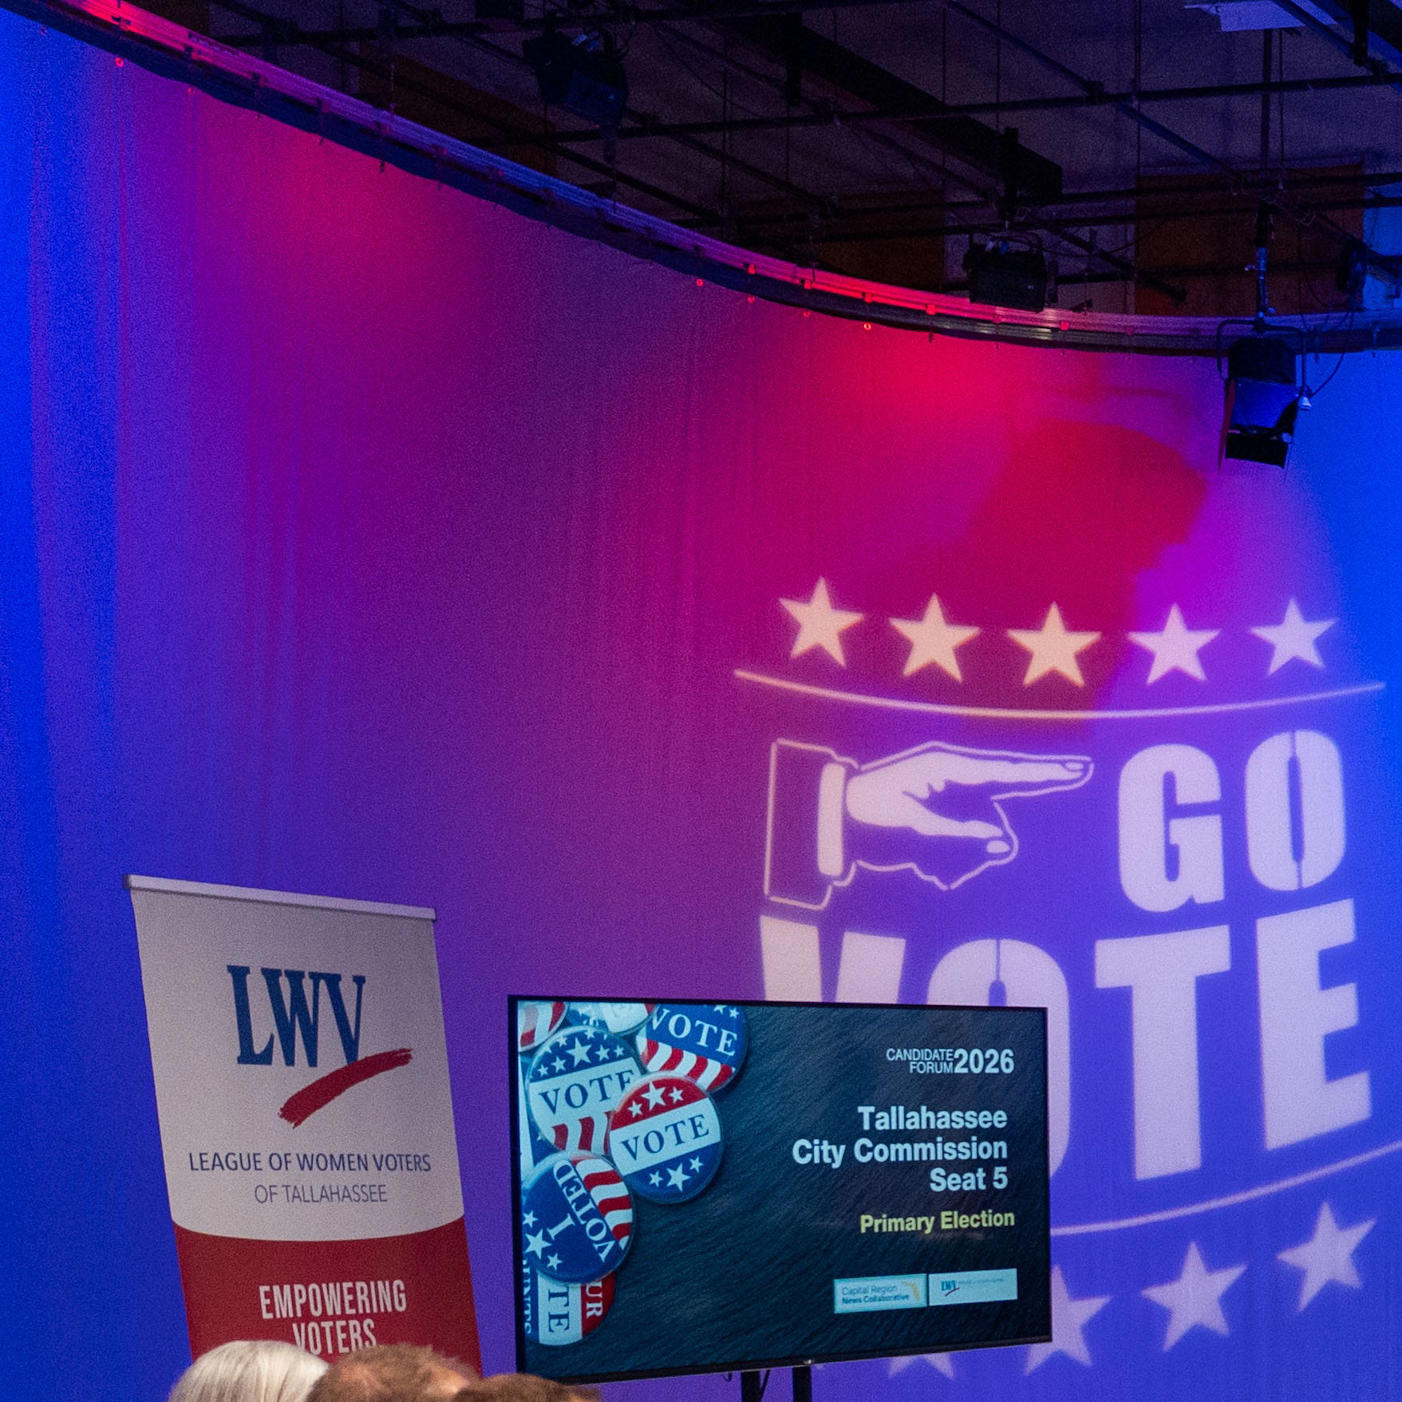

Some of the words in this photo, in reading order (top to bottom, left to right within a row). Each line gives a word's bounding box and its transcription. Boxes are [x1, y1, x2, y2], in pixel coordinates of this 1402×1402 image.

[1118, 730, 1346, 912] GO
[226, 964, 366, 1068] LWV
[651, 1007, 738, 1057] VOTE
[759, 898, 1371, 1181] TE
[886, 1048, 954, 1061] CANDIDATE
[909, 1061, 954, 1074] FORUM
[953, 1048, 1015, 1074] 2026
[857, 1105, 1008, 1130] Tallahassee
[620, 1114, 710, 1162] VOTE
[792, 1138, 846, 1169] City
[853, 1136, 1008, 1163] Commission
[189, 1152, 263, 1172] LEAGUE
[269, 1152, 292, 1172] OF
[296, 1152, 369, 1172] WOMEN
[372, 1153, 432, 1173] VOTERS
[254, 1184, 278, 1204] OF
[282, 1184, 388, 1204] TALLAHASSEE
[930, 1167, 986, 1192] Seat
[993, 1166, 1009, 1190] 5
[546, 1213, 576, 1241] I
[554, 1164, 617, 1263] VOTED
[860, 1213, 936, 1234] Primary
[940, 1209, 1016, 1230] Election
[259, 1279, 408, 1320] EMPOWERING
[841, 1286, 870, 1297] Capital
[548, 1285, 570, 1333] TE
[292, 1318, 377, 1356] VOTERS
